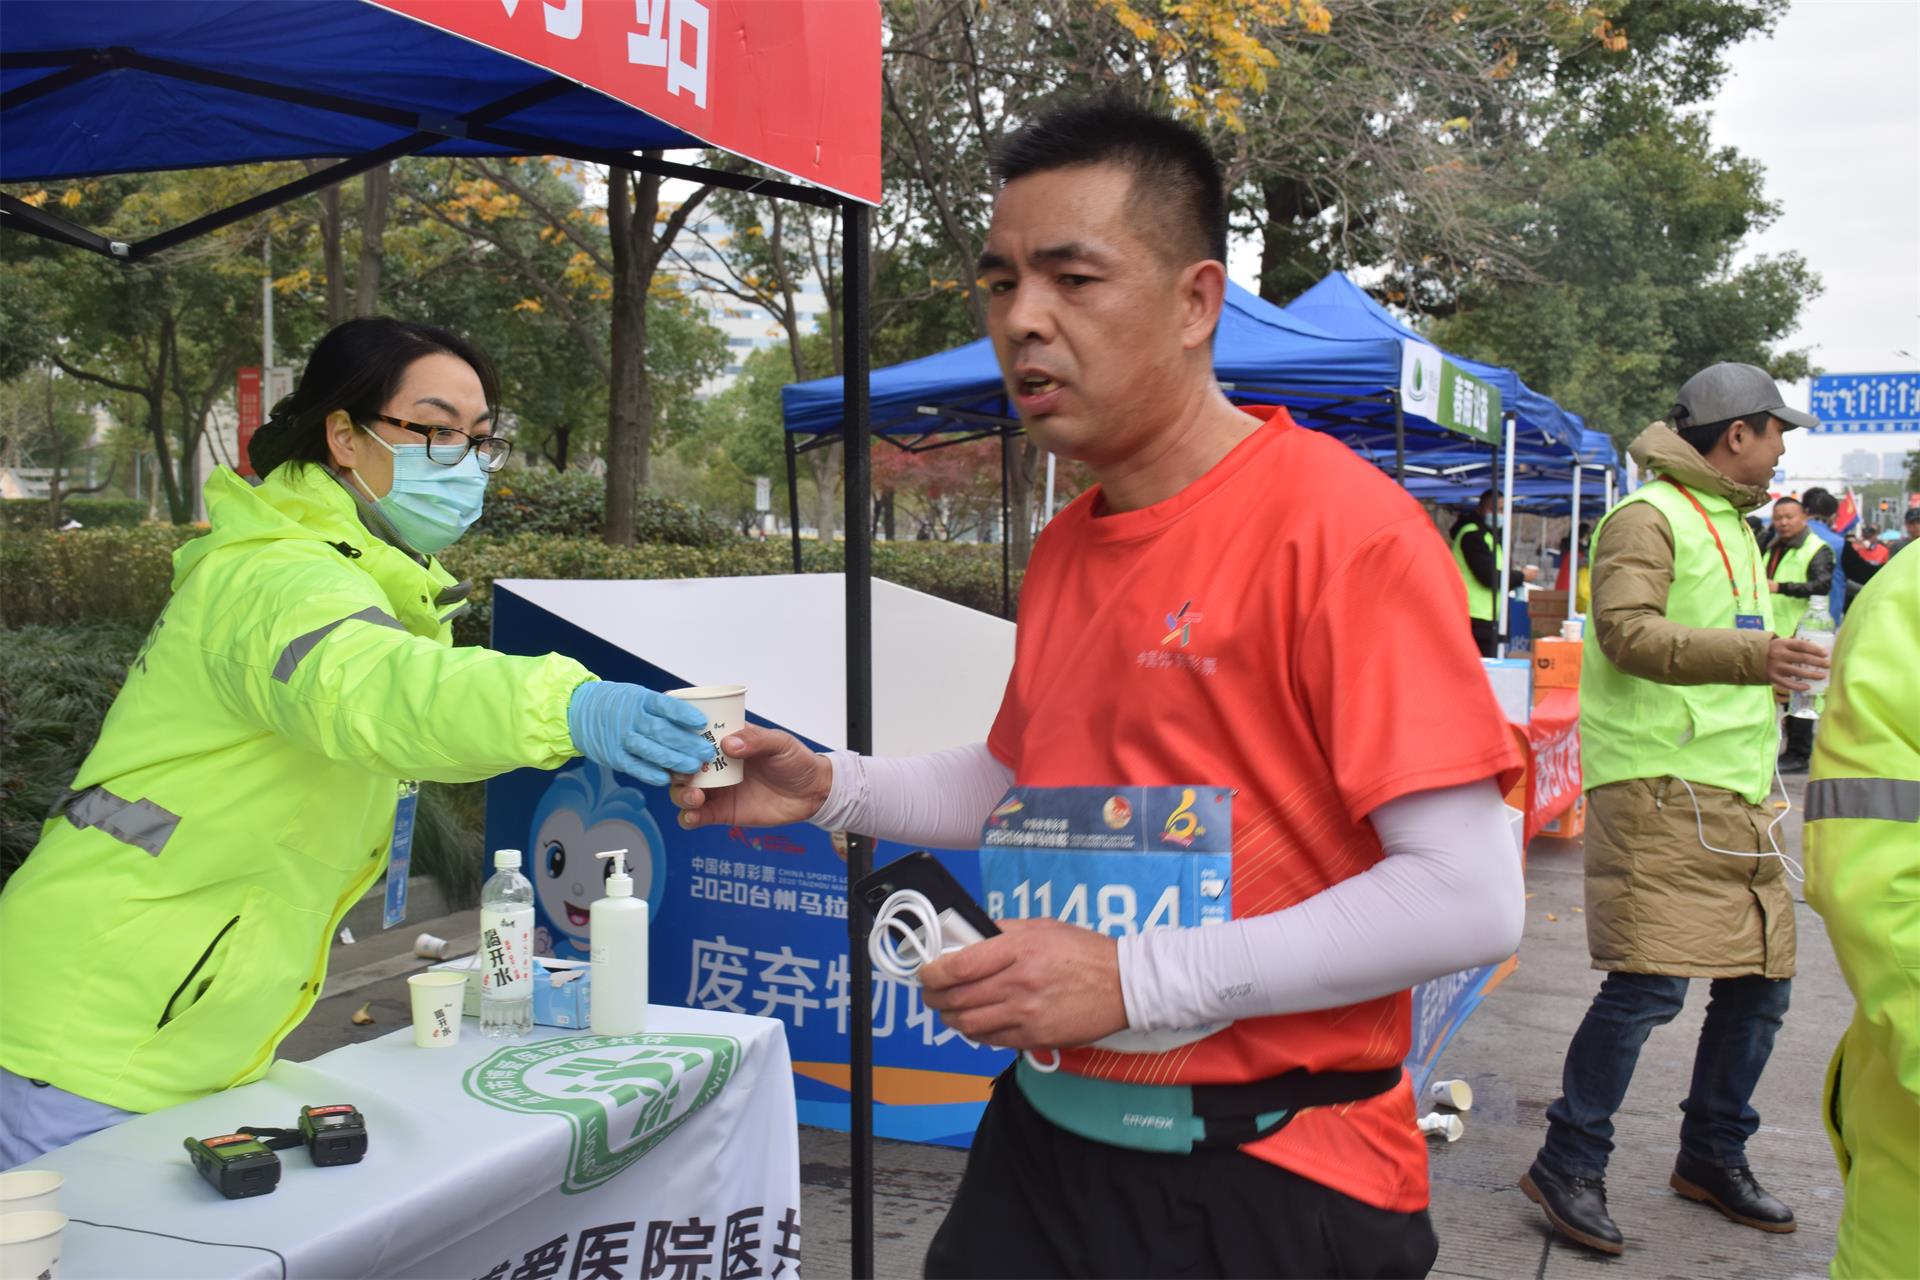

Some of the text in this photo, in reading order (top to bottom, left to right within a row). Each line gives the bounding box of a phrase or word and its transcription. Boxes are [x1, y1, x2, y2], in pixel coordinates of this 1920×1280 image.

[691, 855, 776, 884] 中国体育彩票
[778, 868, 805, 879] CHINA
[806, 872, 837, 883] SPORTS
[691, 876, 849, 919] 2020台州马拉
[1012, 879, 1181, 938] 11484
